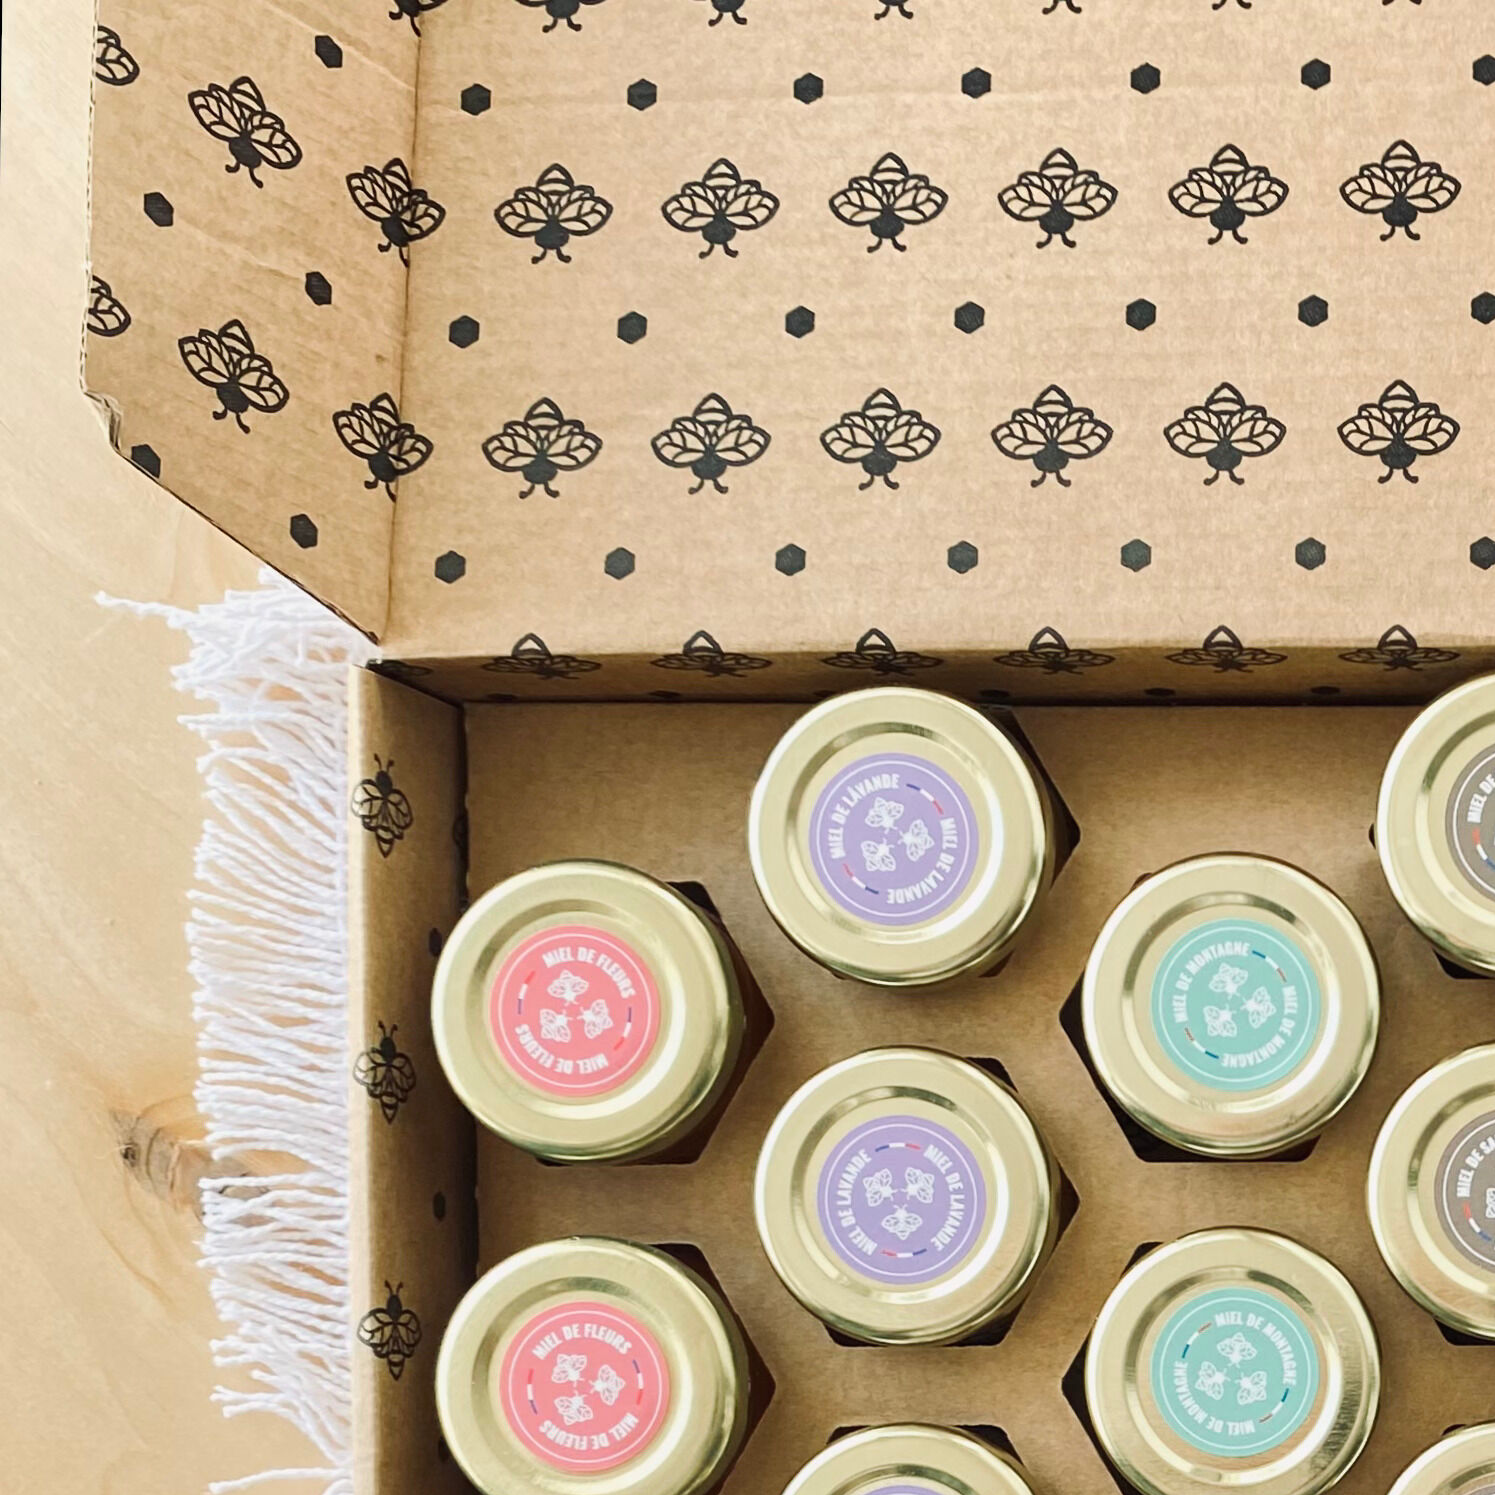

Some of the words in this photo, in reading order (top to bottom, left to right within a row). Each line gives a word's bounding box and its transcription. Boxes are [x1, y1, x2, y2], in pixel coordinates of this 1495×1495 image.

[842, 774, 900, 807] LAVANDE
[832, 804, 850, 824] DE
[1468, 794, 1487, 822] MIEL
[828, 828, 846, 858] MIEL
[940, 818, 957, 849] MIEL
[936, 853, 954, 872] DE
[887, 870, 944, 904] LAVANDE
[542, 947, 574, 968] MIEL
[577, 947, 596, 963] DE
[596, 954, 636, 998] FLEURS
[1186, 941, 1250, 975] MONTAGNE
[1176, 973, 1192, 990] DE
[1172, 994, 1188, 1022] MIEL
[1282, 986, 1298, 1014] MIEL
[1279, 1018, 1295, 1036] DE
[515, 1024, 554, 1068] FLEURS
[1222, 1034, 1285, 1068] MONTAGNE
[555, 1058, 574, 1074] DE
[576, 1054, 608, 1074] MIEL
[924, 1144, 952, 1174] MIEL
[1457, 1170, 1474, 1197] MIEL
[1466, 1149, 1484, 1168] DE
[837, 1149, 872, 1205] LAVANDE
[946, 1172, 963, 1191] DE
[838, 1208, 856, 1227] DE
[931, 1194, 964, 1251] LAVANDE
[848, 1226, 877, 1255] MIEL
[532, 1332, 562, 1360] MIEL
[562, 1324, 581, 1340] DE
[584, 1324, 632, 1354] FLEURS
[1214, 1312, 1243, 1326] MIEL
[1246, 1313, 1264, 1330] DE
[1262, 1323, 1296, 1385] MONTAGNE
[1174, 1361, 1208, 1424] MONTAGNE
[539, 1420, 587, 1450] FLEURS
[608, 1413, 638, 1440] MIEL
[1206, 1416, 1224, 1432] DE
[1227, 1420, 1255, 1435] MIEL
[590, 1433, 610, 1450] DE
